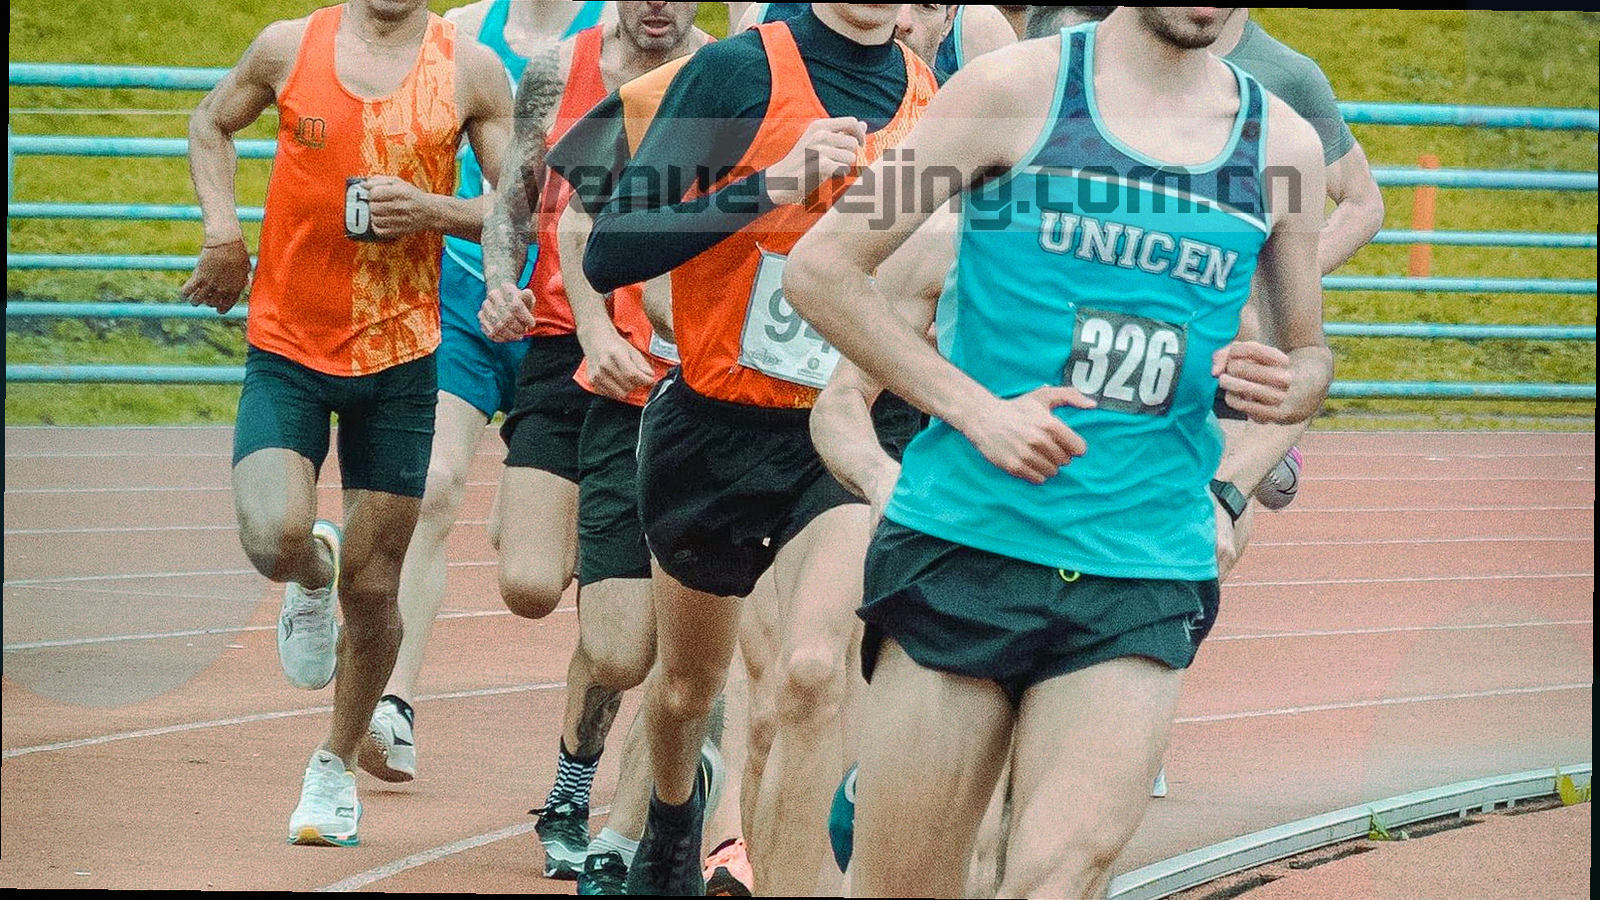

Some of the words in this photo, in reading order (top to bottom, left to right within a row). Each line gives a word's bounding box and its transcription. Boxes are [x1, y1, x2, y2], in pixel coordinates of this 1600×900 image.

[346, 183, 370, 235] 6
[1037, 209, 1239, 292] UNICEN
[1071, 317, 1179, 406] 326
